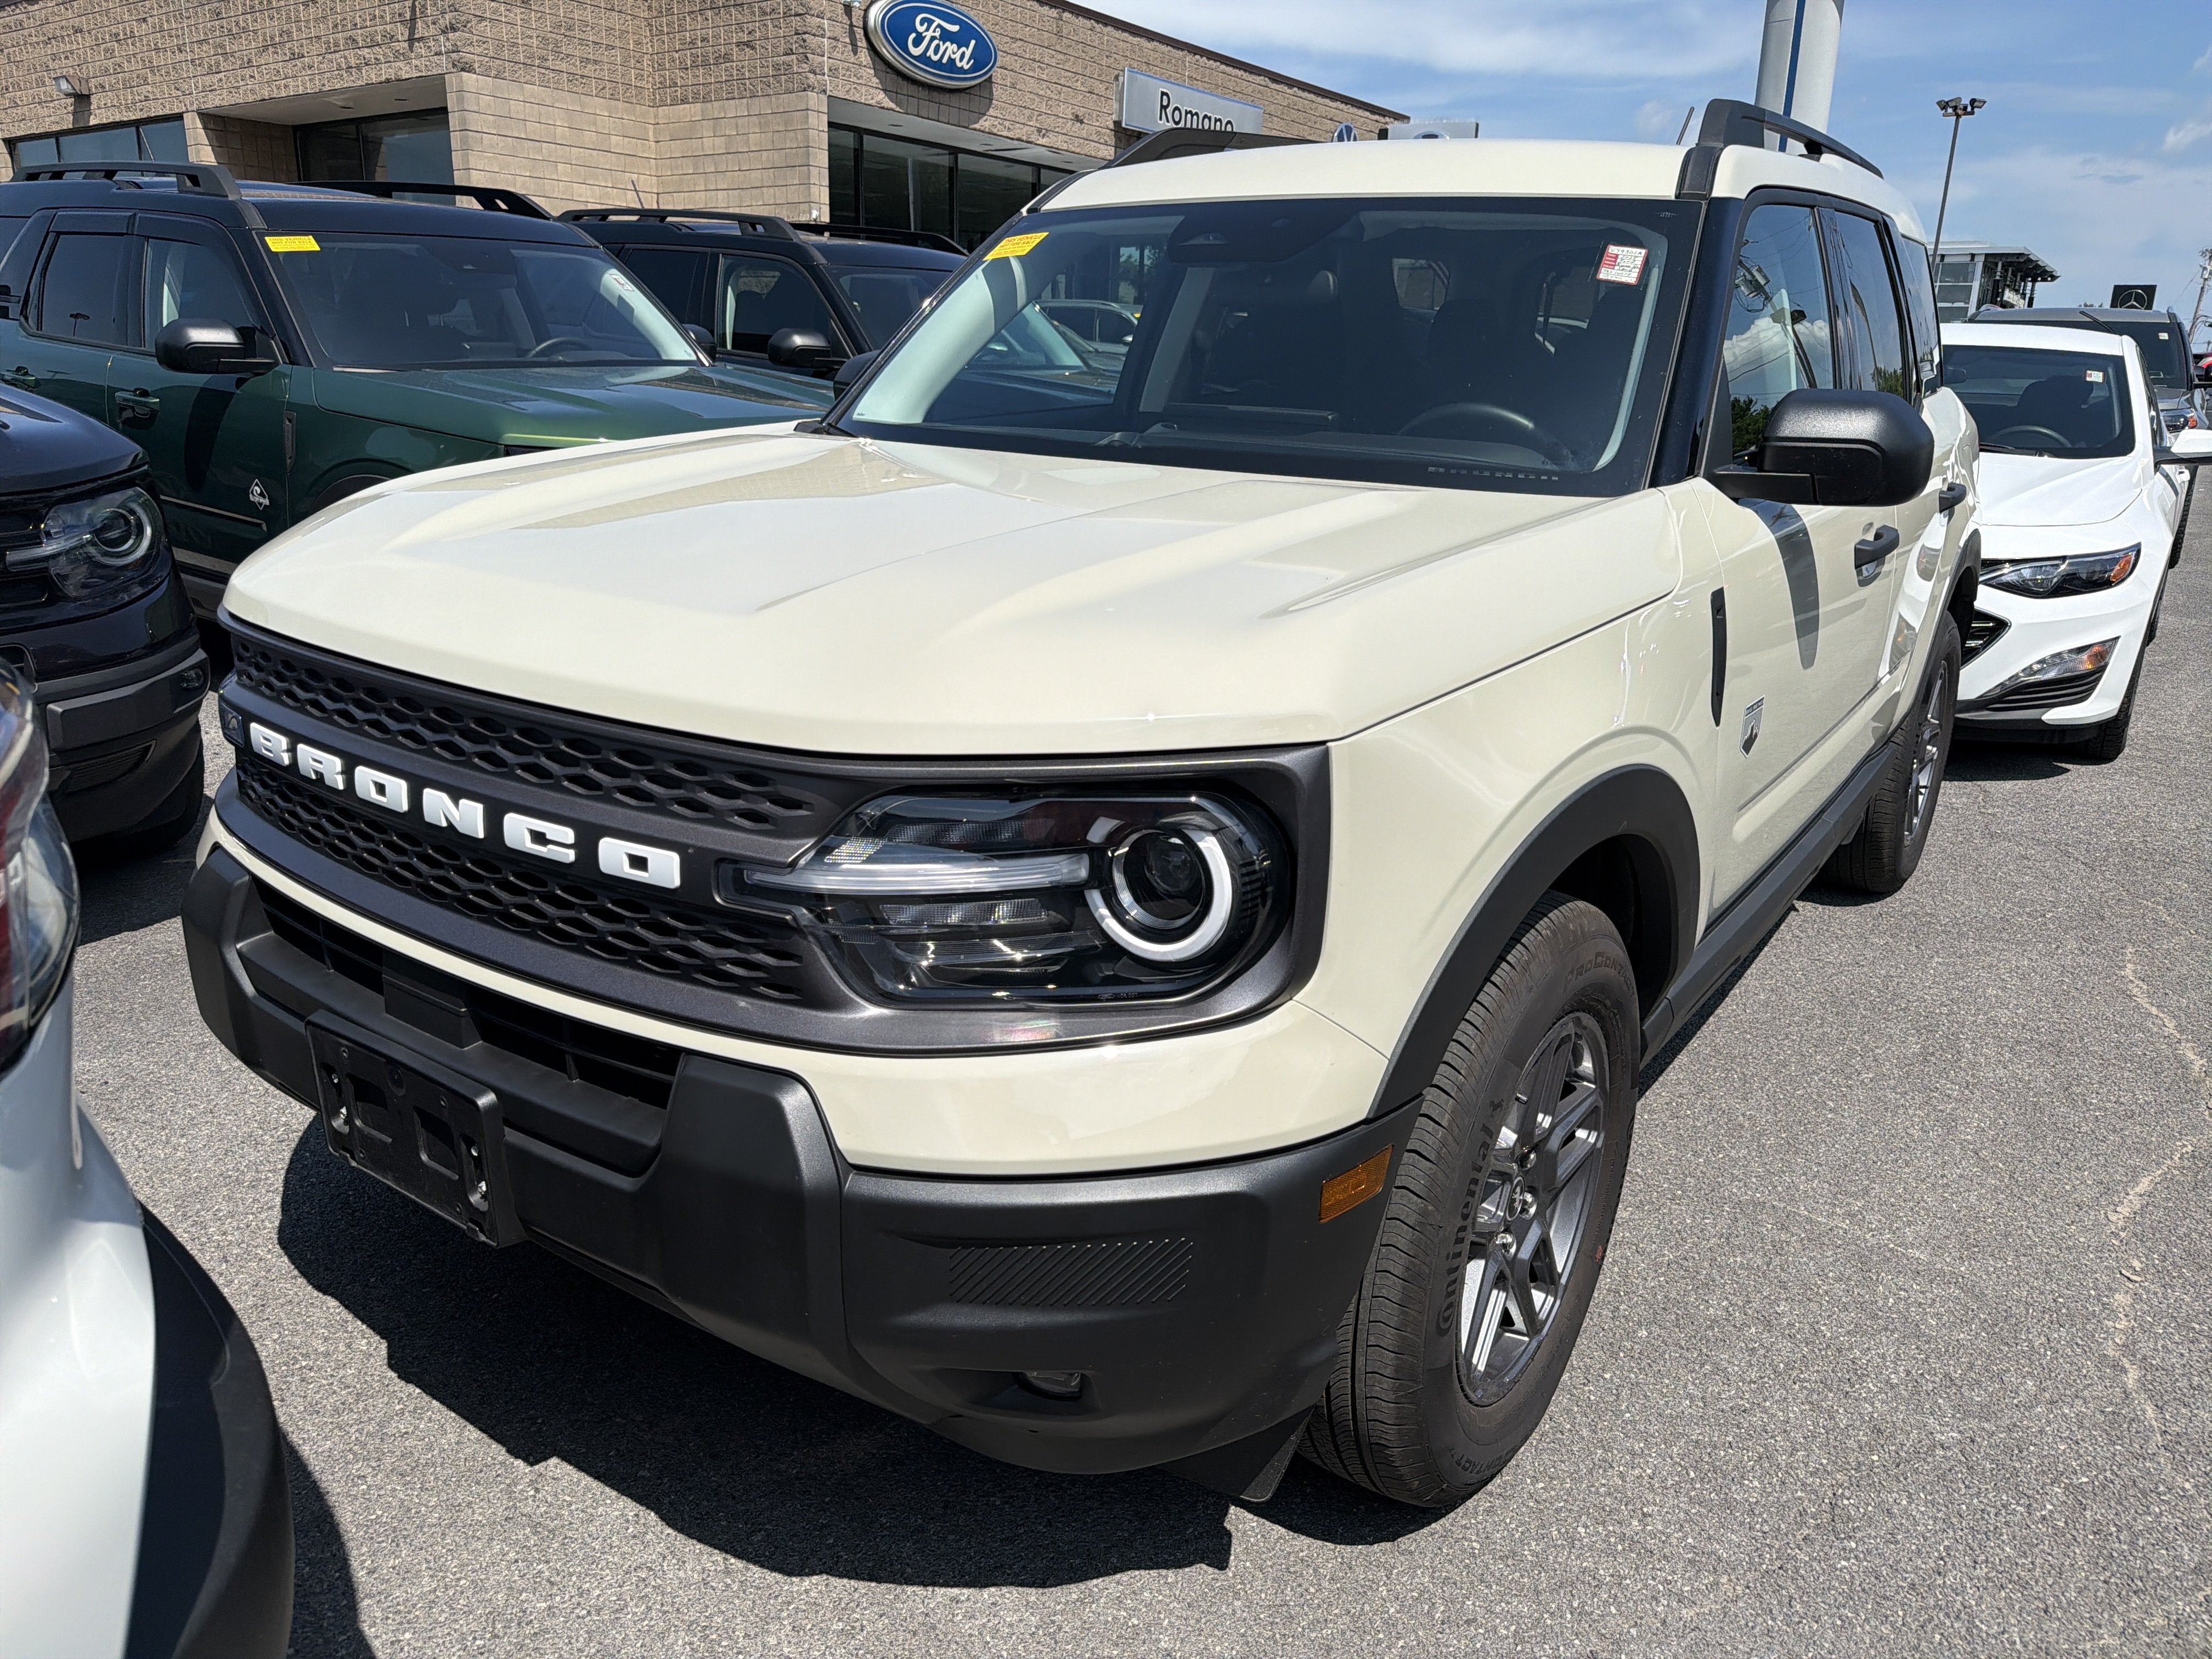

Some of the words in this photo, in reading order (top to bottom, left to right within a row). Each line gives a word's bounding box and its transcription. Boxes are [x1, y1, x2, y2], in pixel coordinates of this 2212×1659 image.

[907, 14, 975, 70] Ford
[1159, 89, 1234, 132] Romano
[250, 722, 681, 889] BRONCO
[1436, 1124, 1493, 1338] Continental
